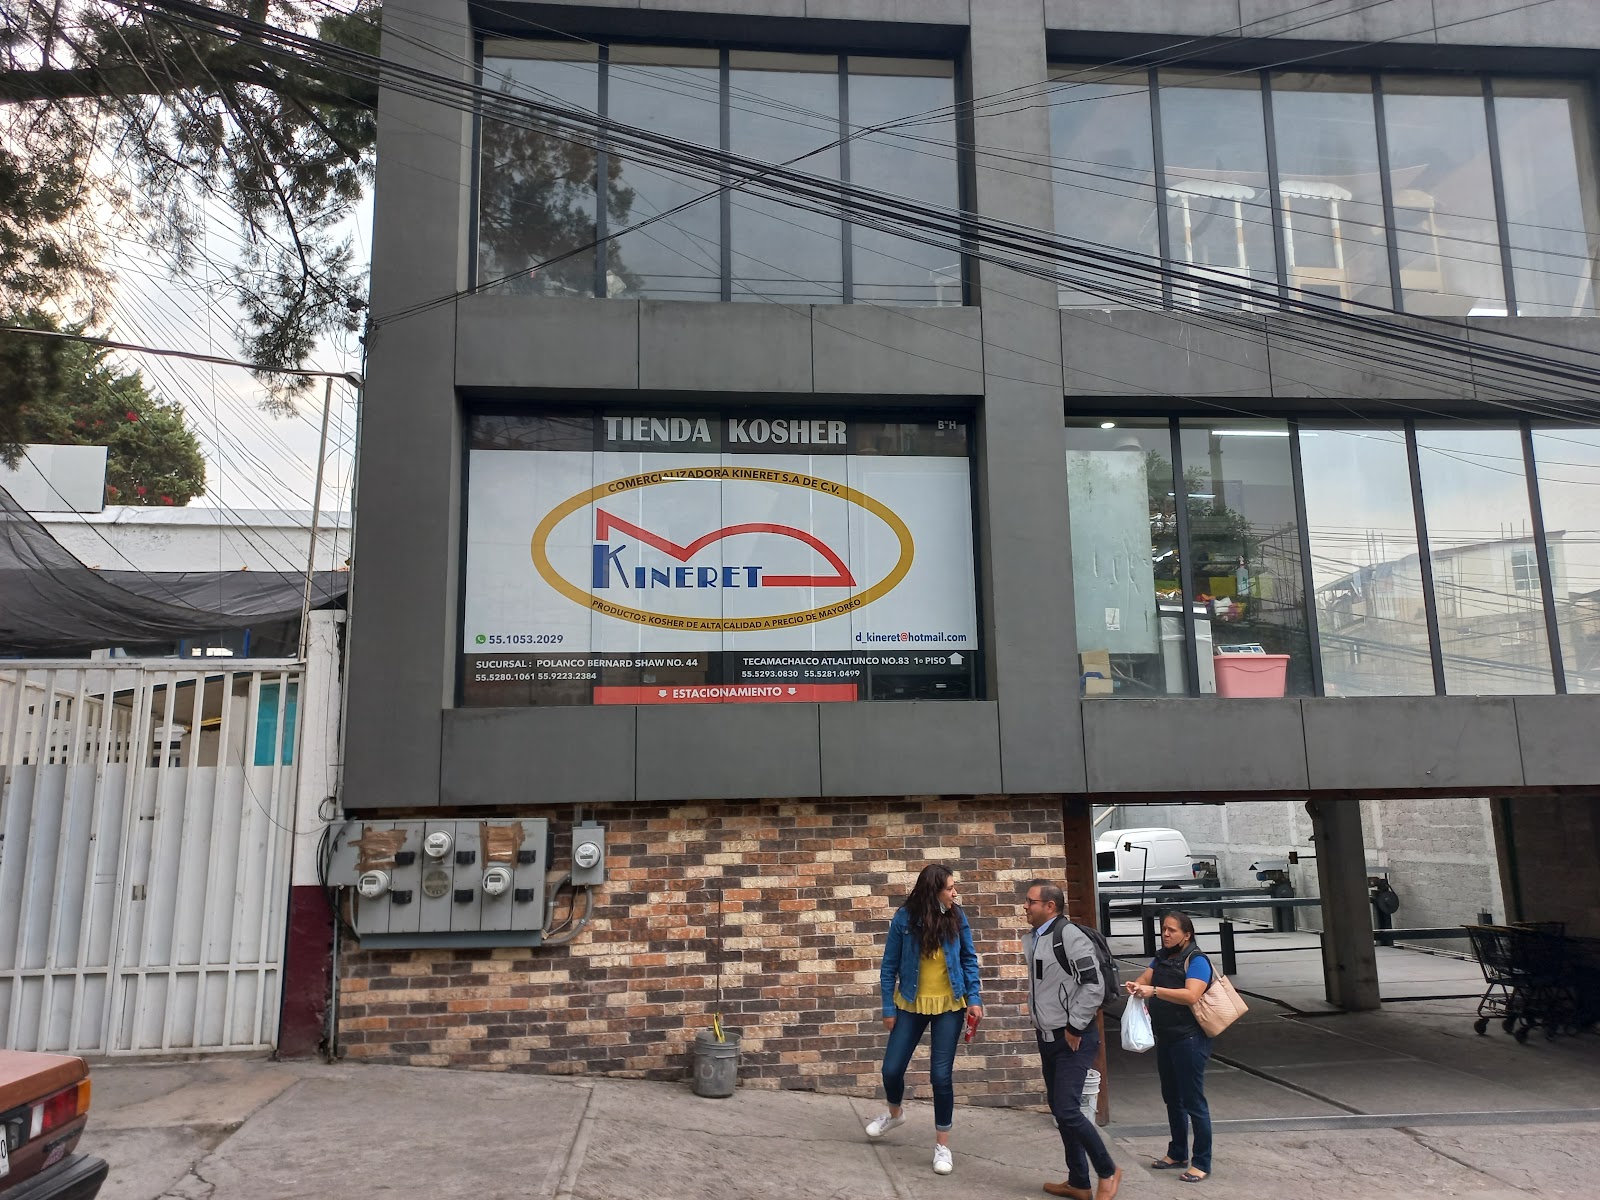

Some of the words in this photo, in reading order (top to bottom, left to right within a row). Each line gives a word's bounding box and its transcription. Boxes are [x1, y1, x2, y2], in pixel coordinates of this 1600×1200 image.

[602, 416, 712, 443] TIENDA
[728, 418, 848, 445] KOSHER
[608, 469, 730, 493] COMERCIALIZADORA
[732, 469, 780, 481] KINERET
[802, 477, 818, 488] DE
[820, 482, 840, 495] C.V.
[592, 544, 763, 588] KINERET
[592, 600, 647, 622] PRODUCTOS
[648, 616, 684, 628] KOSHER
[686, 621, 699, 629] DE
[700, 622, 722, 630] ALTA
[723, 621, 762, 630] CALIDAD
[764, 620, 771, 628] A
[772, 615, 804, 627] PRECIO
[805, 613, 818, 622] DE
[818, 599, 861, 619] MAYOREO
[489, 634, 564, 645] 55.1053.2029
[855, 631, 967, 644] d_kineret@hotmail.com
[536, 659, 586, 668] POLANCO
[587, 659, 633, 668] BERNARD
[634, 659, 665, 668] SHAW
[666, 659, 685, 667] NO.
[685, 658, 699, 667] 44
[742, 657, 820, 666] TECAMACHALCO
[820, 657, 880, 666] ATLALTUNCO
[881, 656, 910, 665] NO.83
[925, 656, 947, 665] PISO
[475, 673, 535, 682] 55.5280.1061
[537, 672, 597, 680] 55.9223.2384
[741, 670, 799, 678] 55.5293.0830
[804, 670, 861, 678] 55.5281.0499
[672, 686, 783, 699] ESTACIONAMIENTO
